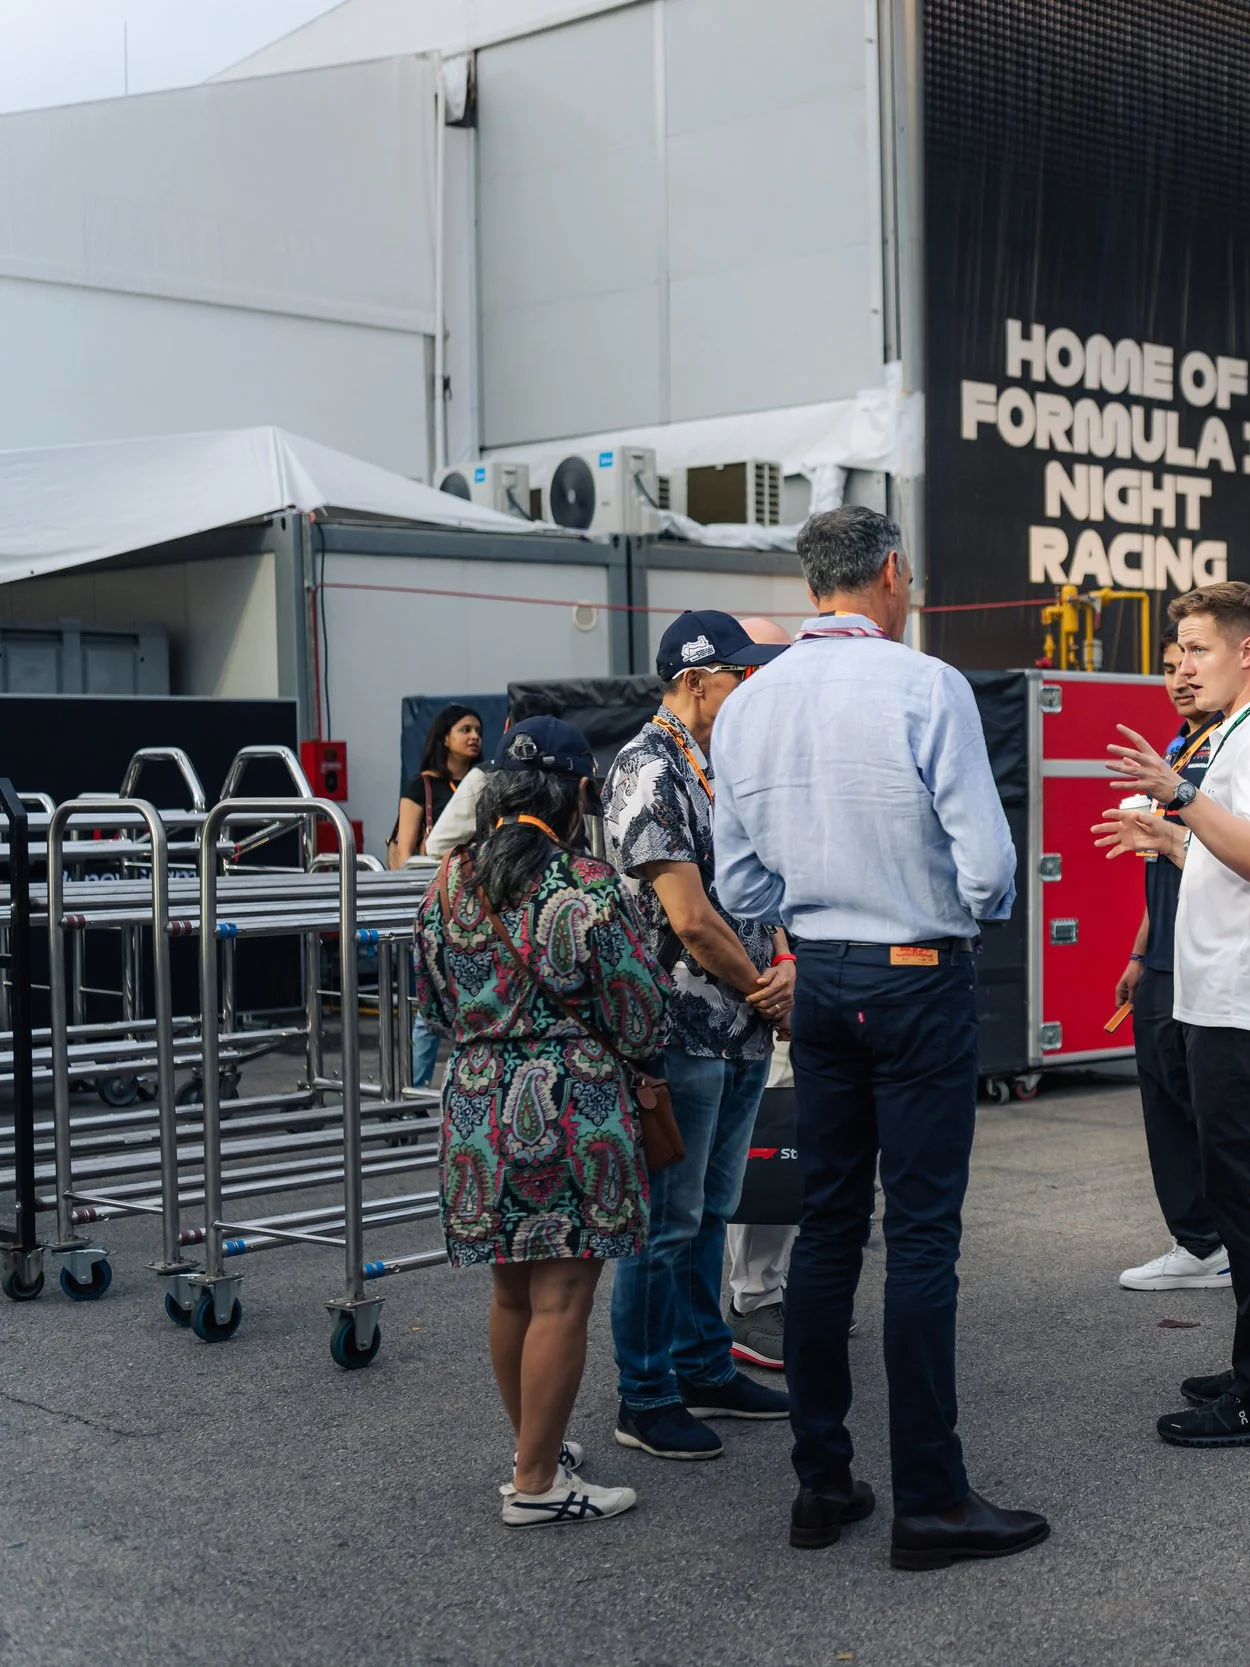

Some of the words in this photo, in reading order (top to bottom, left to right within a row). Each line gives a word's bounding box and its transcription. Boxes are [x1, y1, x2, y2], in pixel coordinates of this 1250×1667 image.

[1006, 318, 1174, 400] HOME
[1180, 350, 1248, 410] OF
[961, 379, 1236, 472] FORMULA
[1044, 460, 1213, 530] NIGHT
[1028, 525, 1228, 592] RACING
